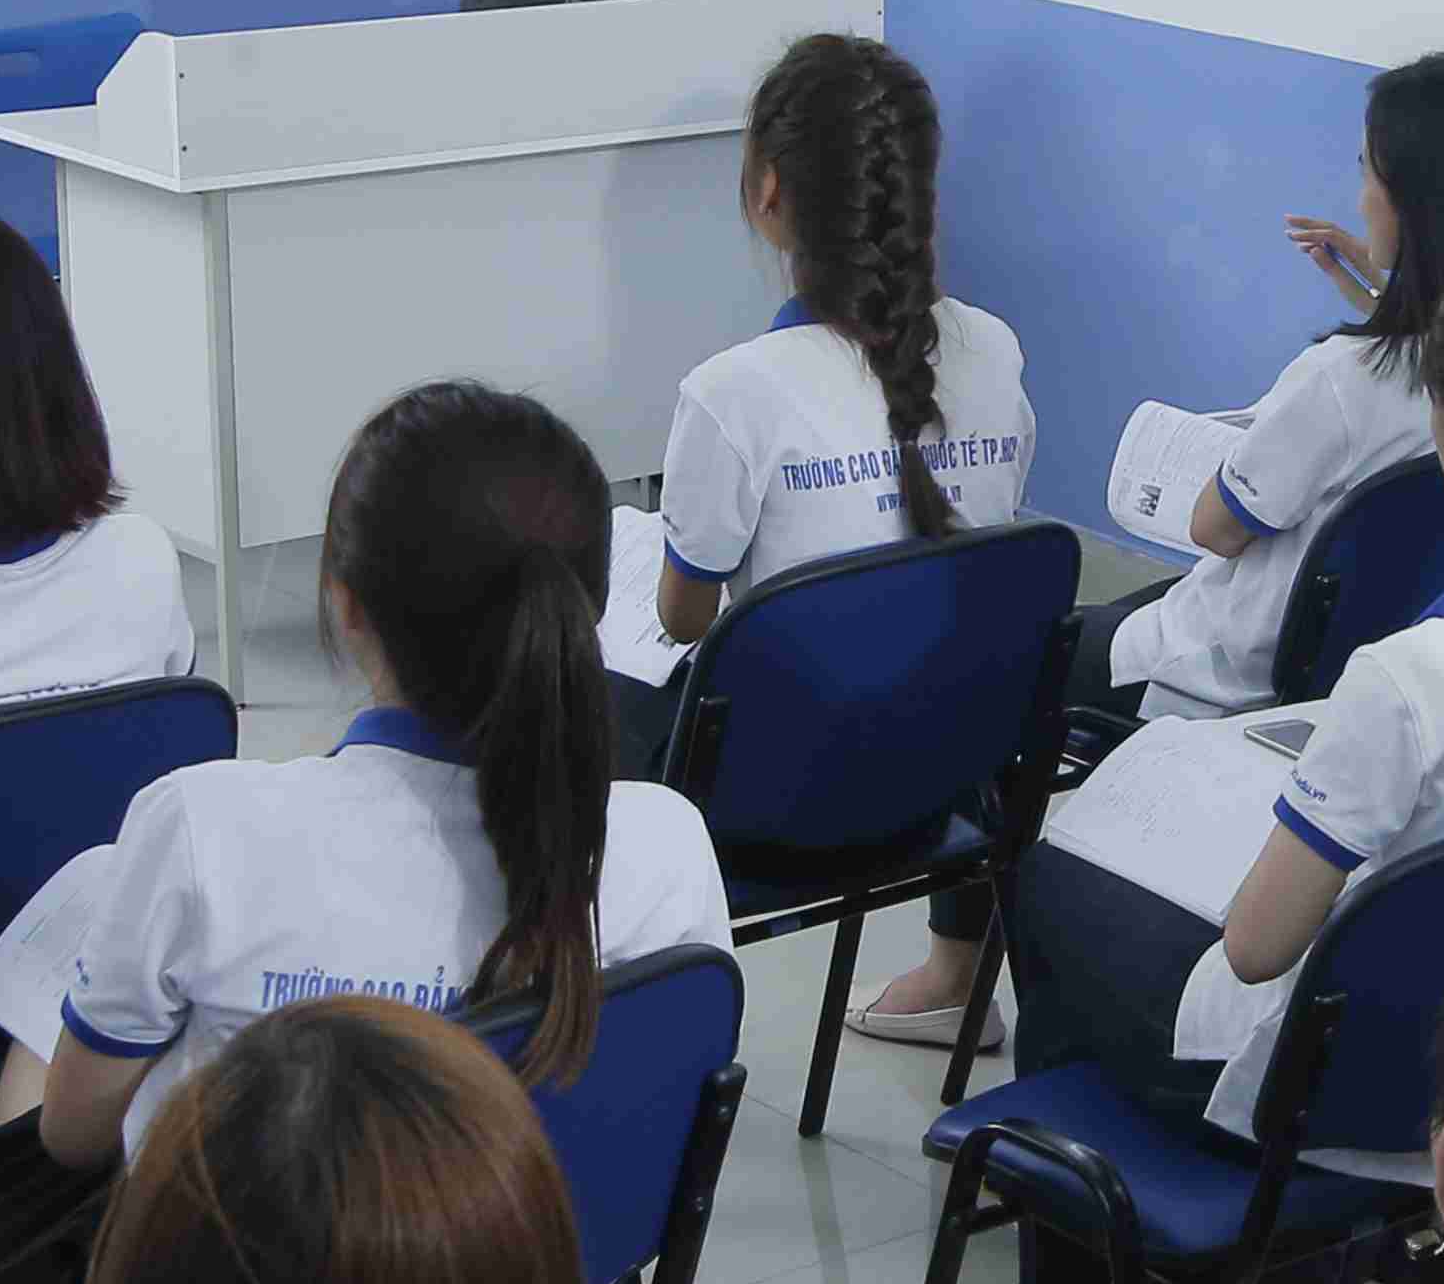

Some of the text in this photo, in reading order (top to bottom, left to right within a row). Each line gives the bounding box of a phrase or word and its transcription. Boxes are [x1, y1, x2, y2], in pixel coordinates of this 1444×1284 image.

[782, 455, 846, 491] TRƯỜNG
[848, 450, 881, 483] CAO
[960, 430, 979, 467] TẾ
